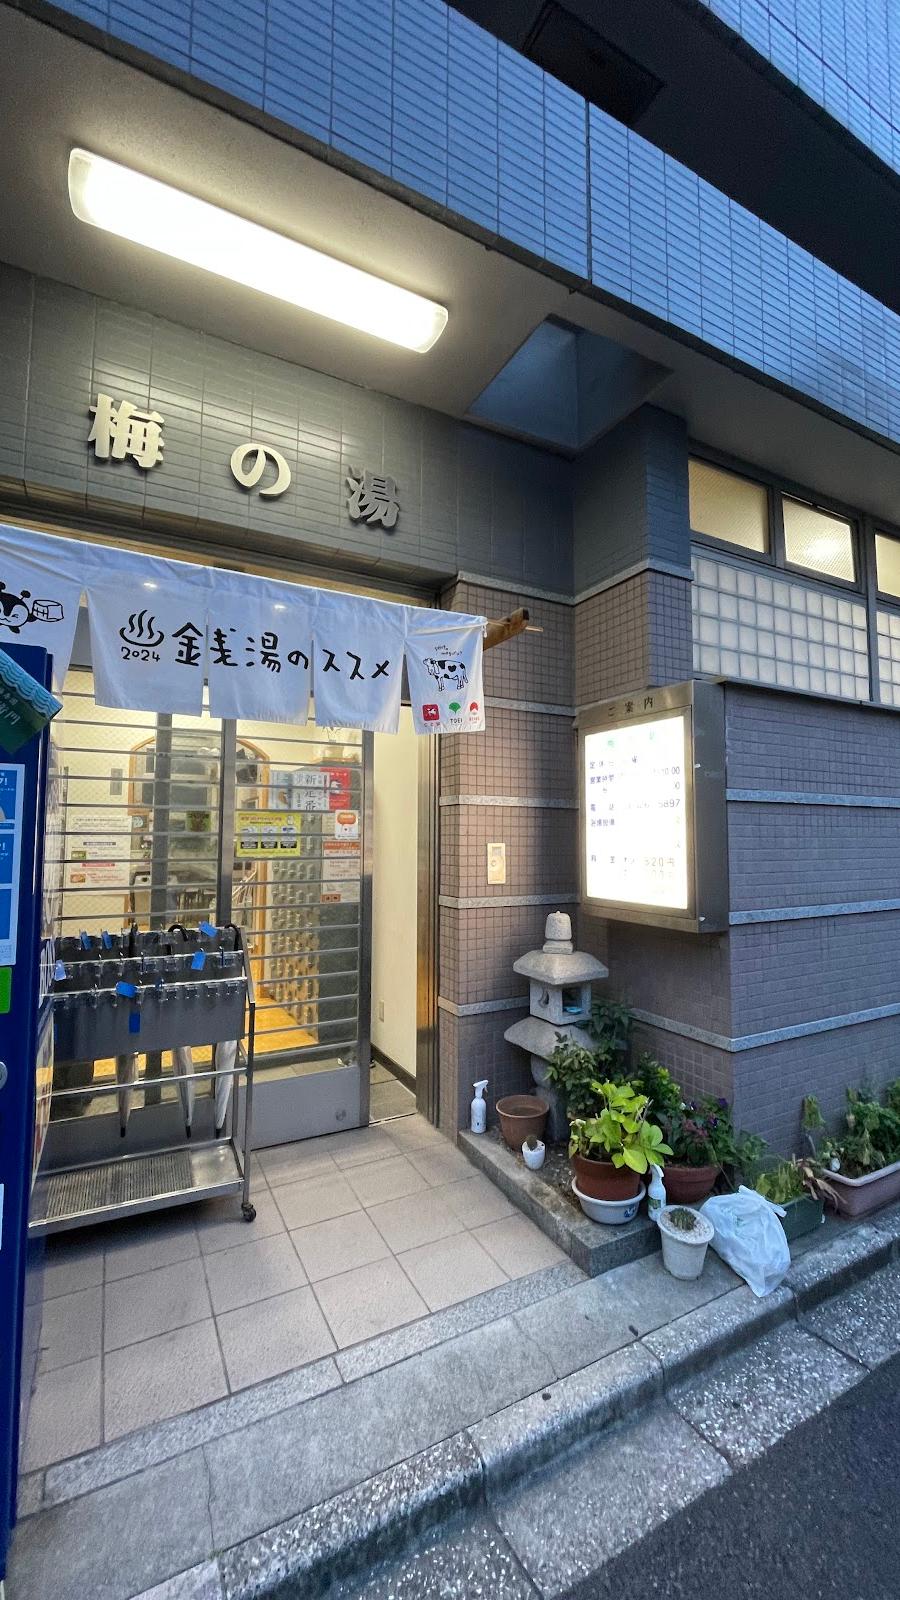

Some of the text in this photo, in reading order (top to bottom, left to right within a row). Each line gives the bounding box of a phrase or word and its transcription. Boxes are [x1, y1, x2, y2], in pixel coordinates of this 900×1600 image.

[88, 393, 402, 529] 梅の湯
[120, 646, 161, 663] 2024
